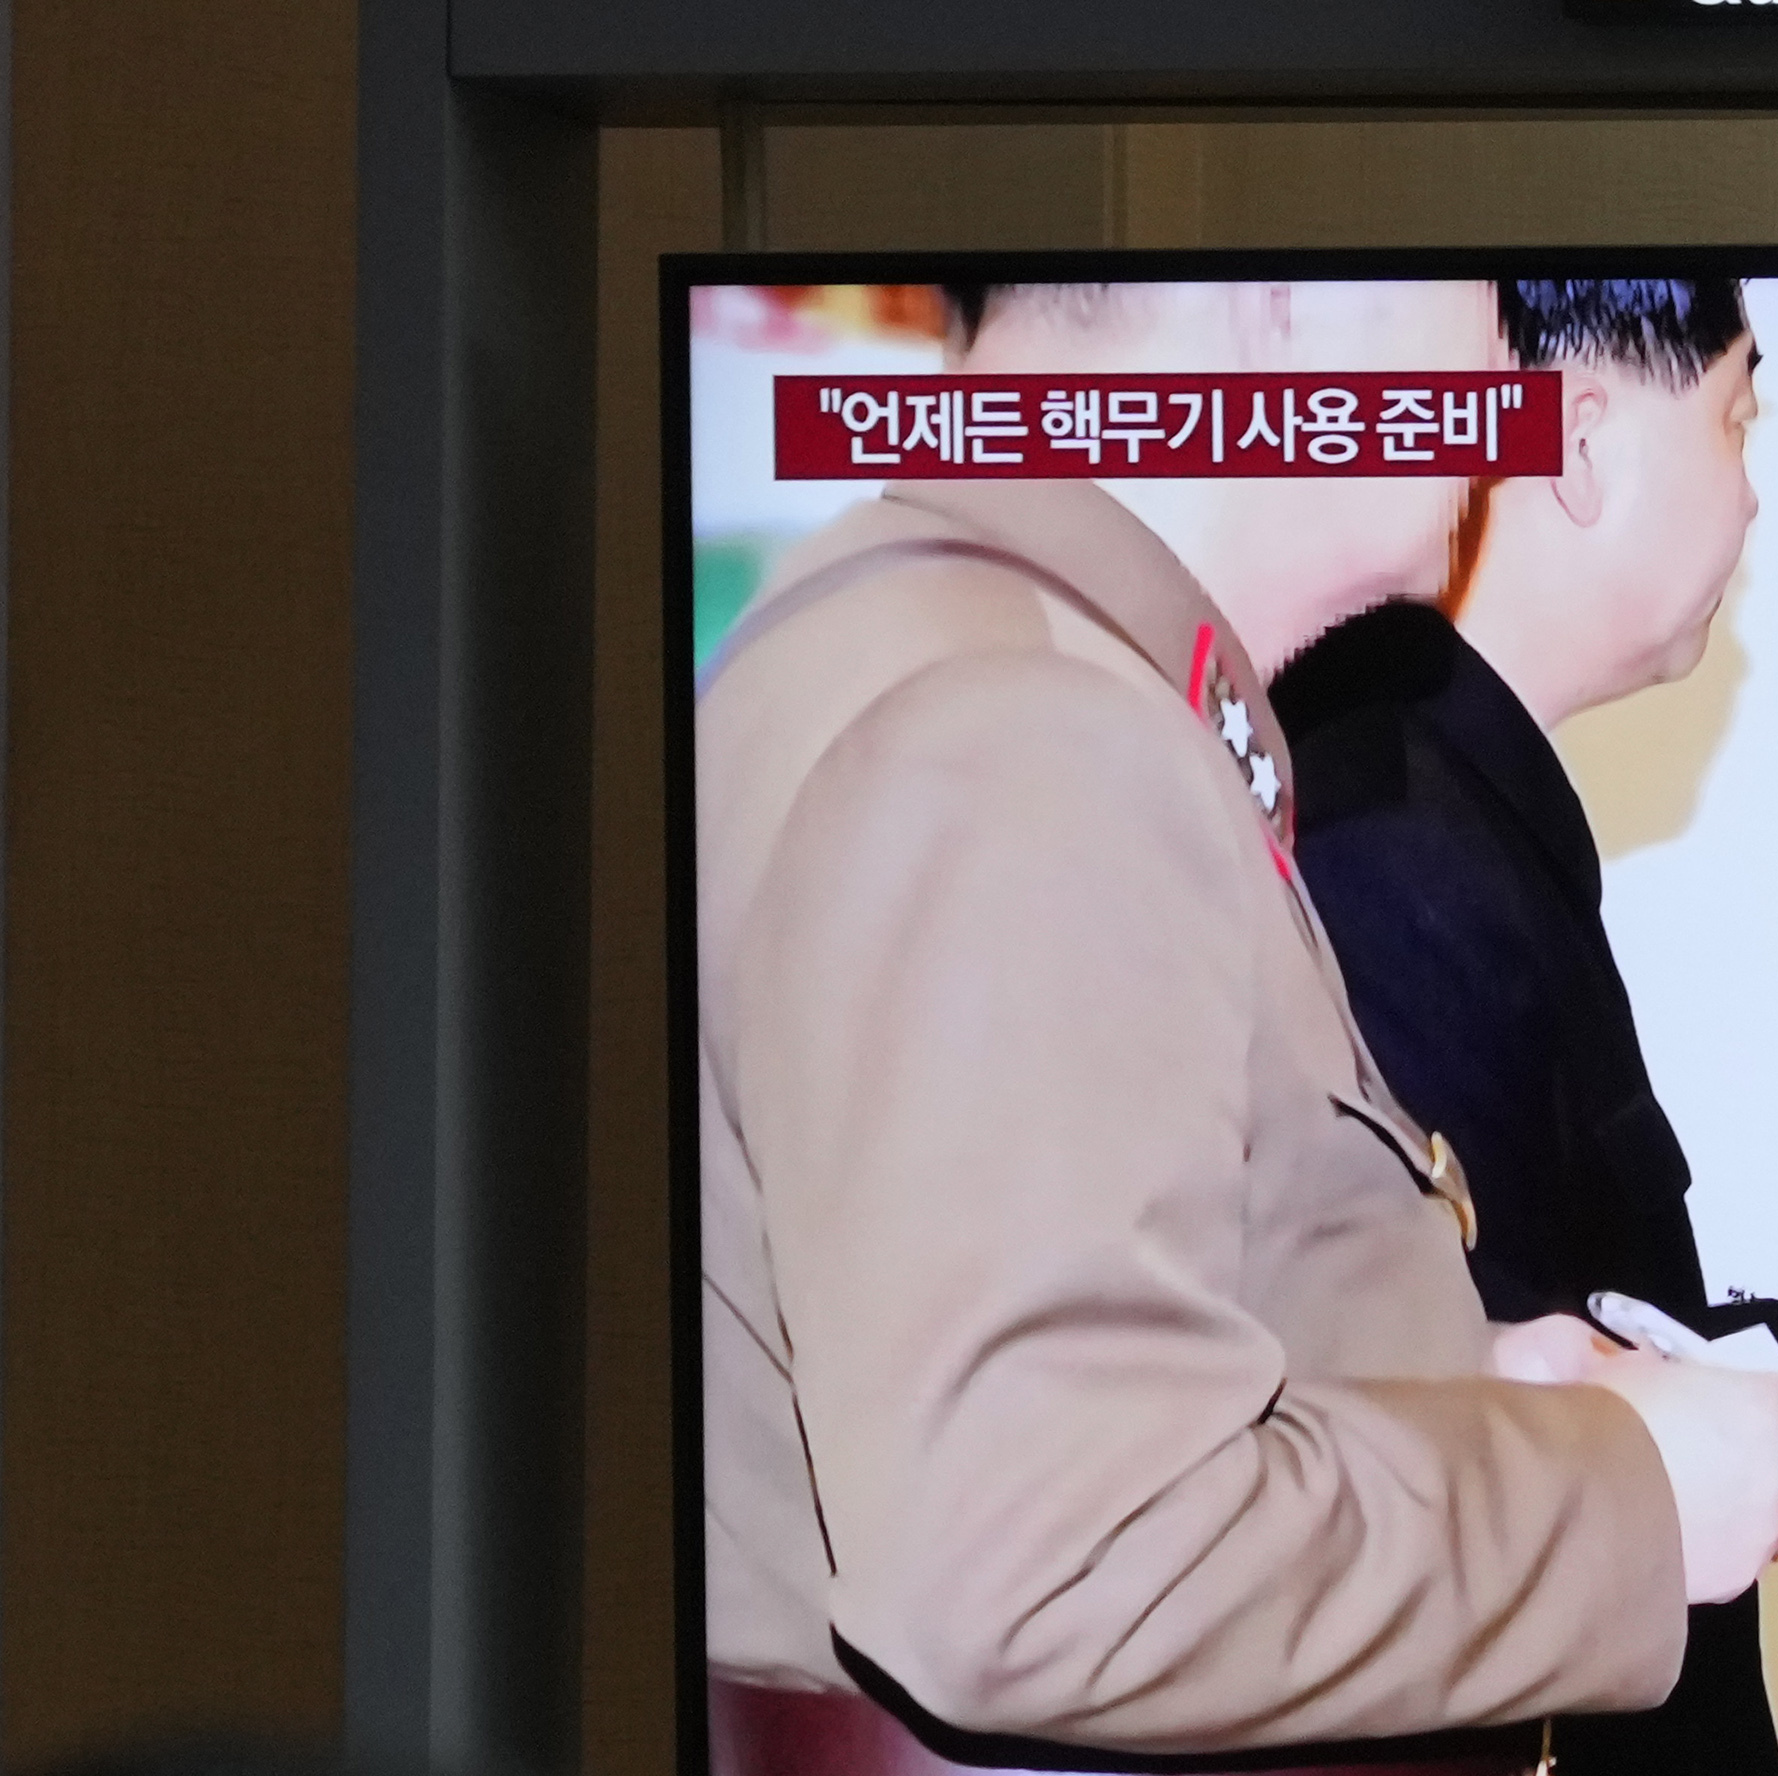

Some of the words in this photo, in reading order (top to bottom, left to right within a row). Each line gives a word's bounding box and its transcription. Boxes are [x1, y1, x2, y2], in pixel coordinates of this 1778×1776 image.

[818, 384, 1030, 465] "언제든
[1040, 387, 1224, 465] 핵무기
[1237, 387, 1367, 464] 사용
[1375, 383, 1524, 462] 준비"
